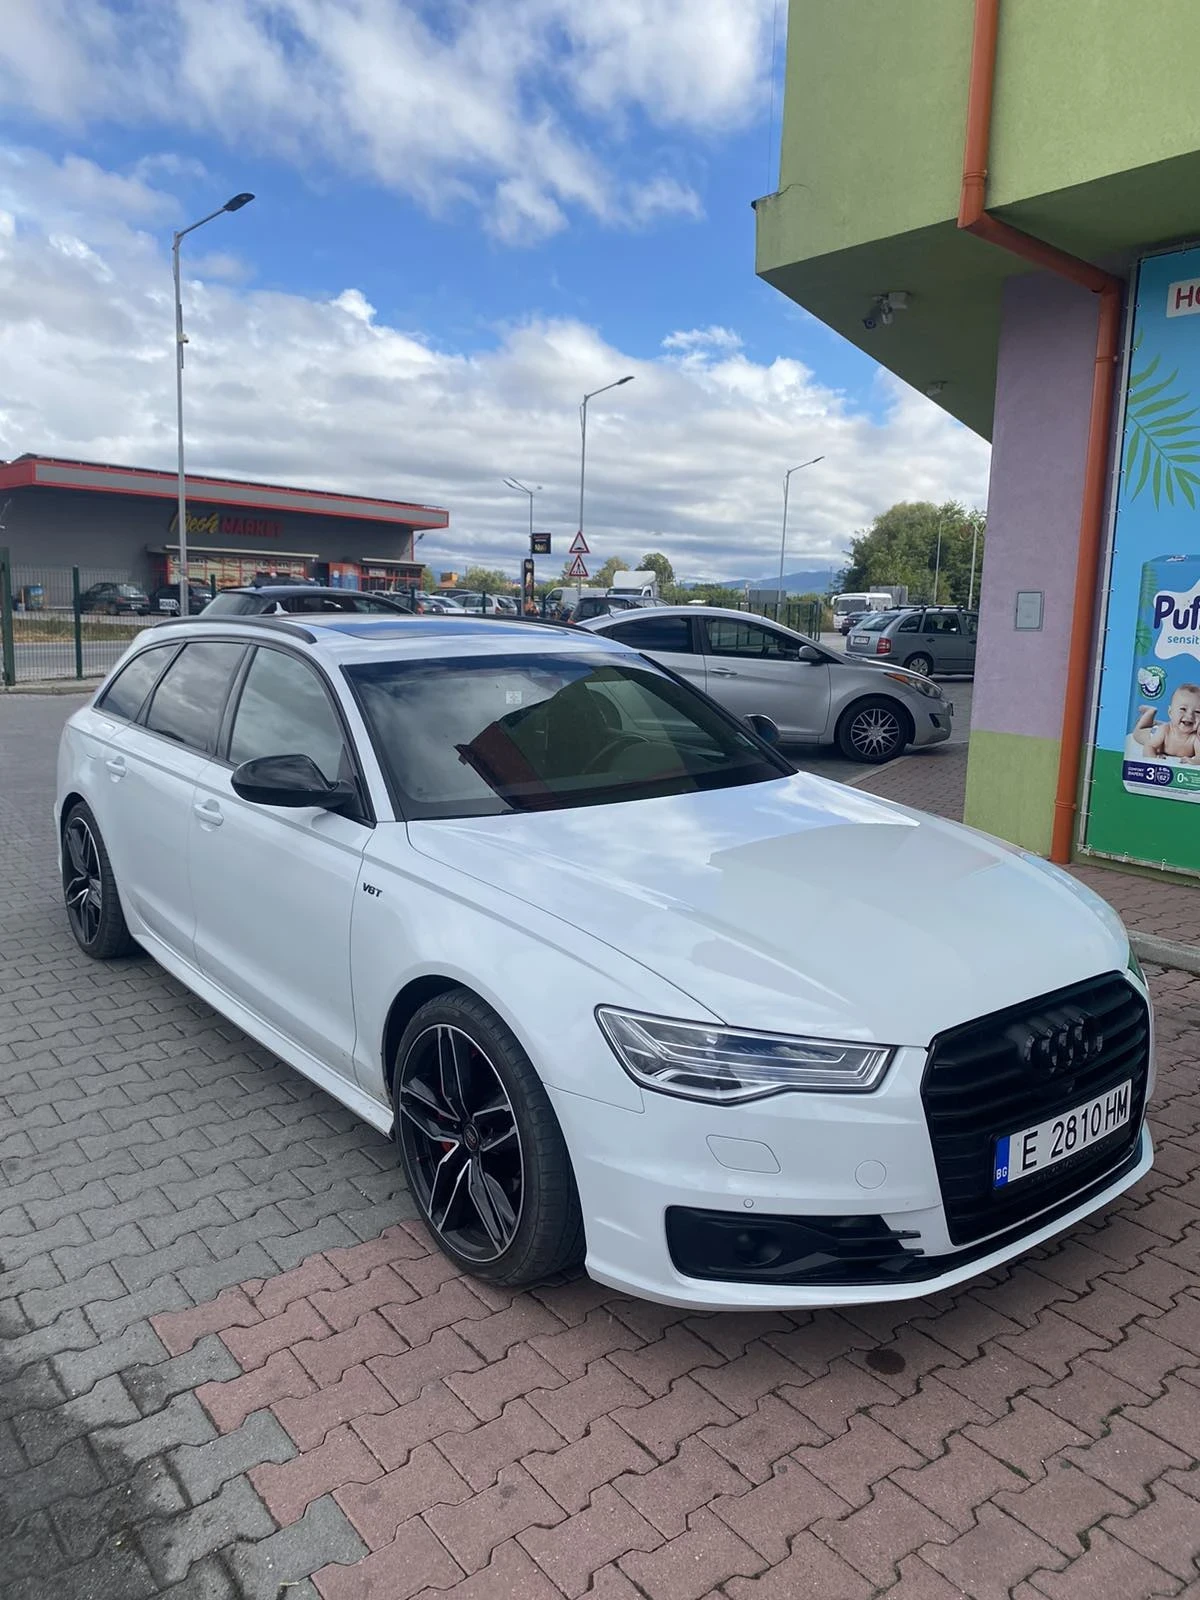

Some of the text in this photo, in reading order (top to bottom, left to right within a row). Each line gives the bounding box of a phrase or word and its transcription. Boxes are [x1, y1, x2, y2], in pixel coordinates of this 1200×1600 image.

[223, 517, 282, 538] MARKET
[1146, 767, 1155, 781] 3
[362, 882, 383, 898] V6T
[1022, 1130, 1039, 1171] E
[996, 1166, 1008, 1180] BG
